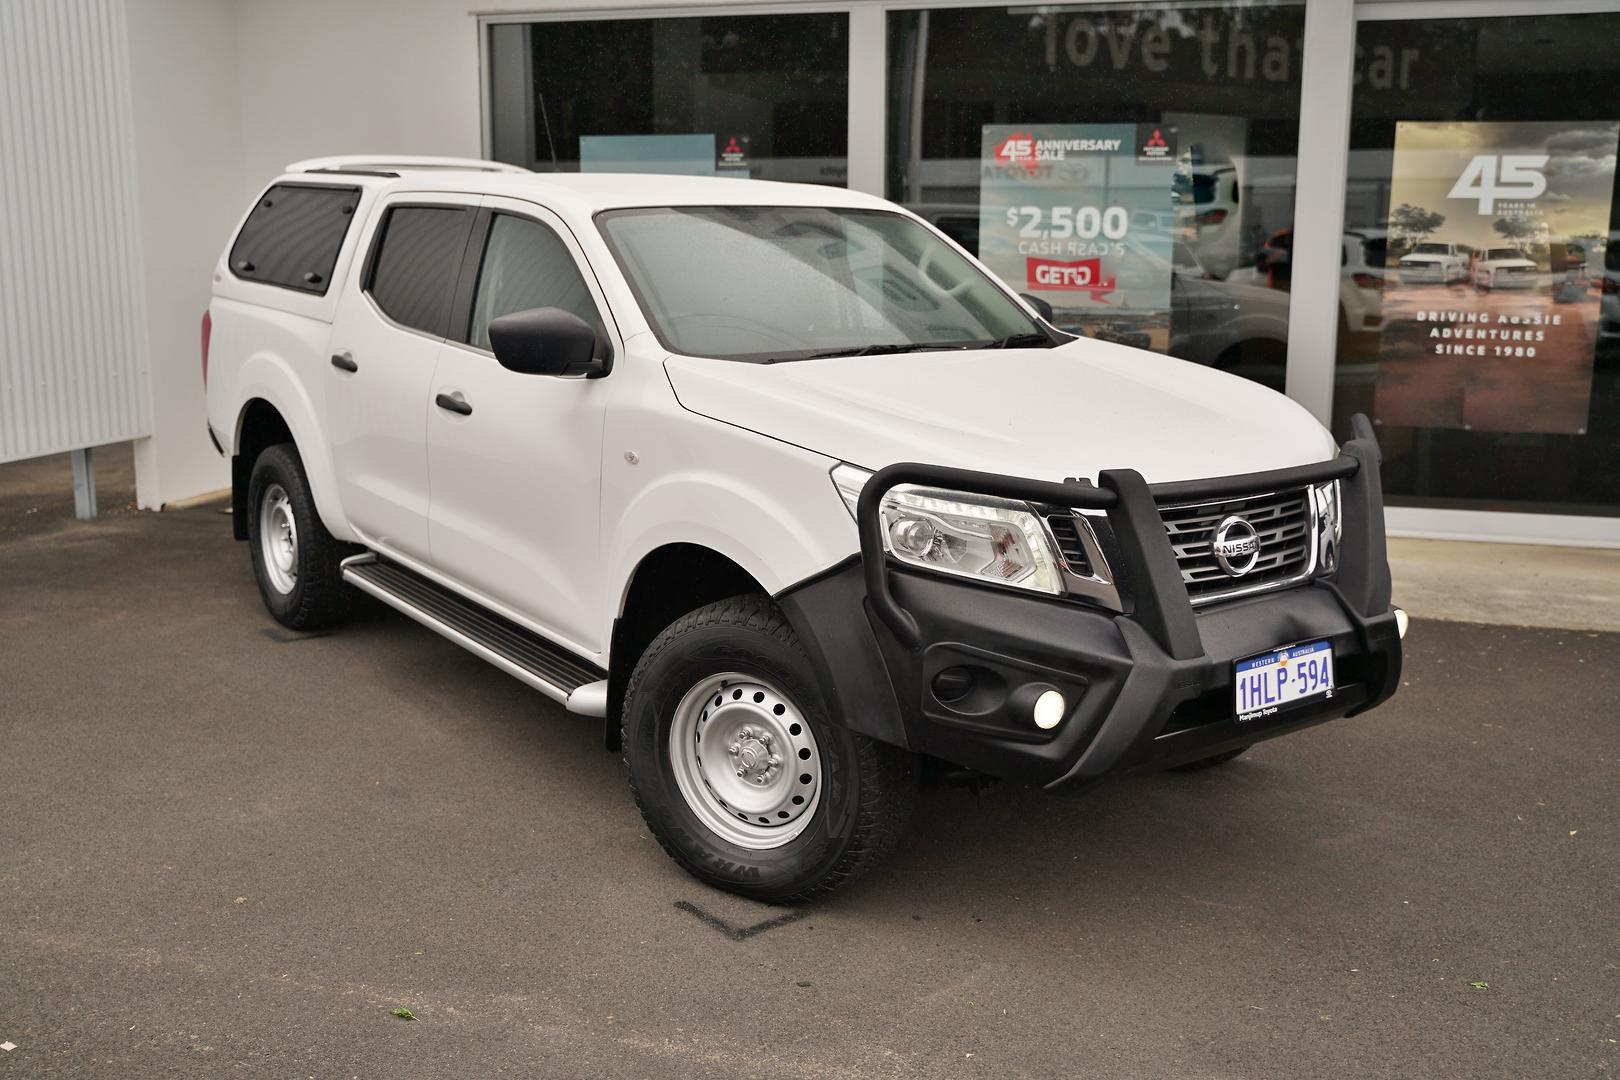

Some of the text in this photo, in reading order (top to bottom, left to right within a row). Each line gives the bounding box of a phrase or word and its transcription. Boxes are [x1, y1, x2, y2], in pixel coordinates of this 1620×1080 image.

[1045, 14, 1172, 73] love
[1199, 13, 1300, 82] tha
[1000, 139, 1121, 162] 45 ANNIVERSARY
[1034, 150, 1066, 161] SALE
[1446, 155, 1550, 215] 45
[1006, 206, 1129, 240] $2,500
[1018, 242, 1062, 255] CASH
[1416, 310, 1490, 324] DRIVING
[1429, 327, 1546, 342] ADVENTURES
[1435, 343, 1537, 358] SINCE 1980
[1262, 706, 1278, 716] Toyota
